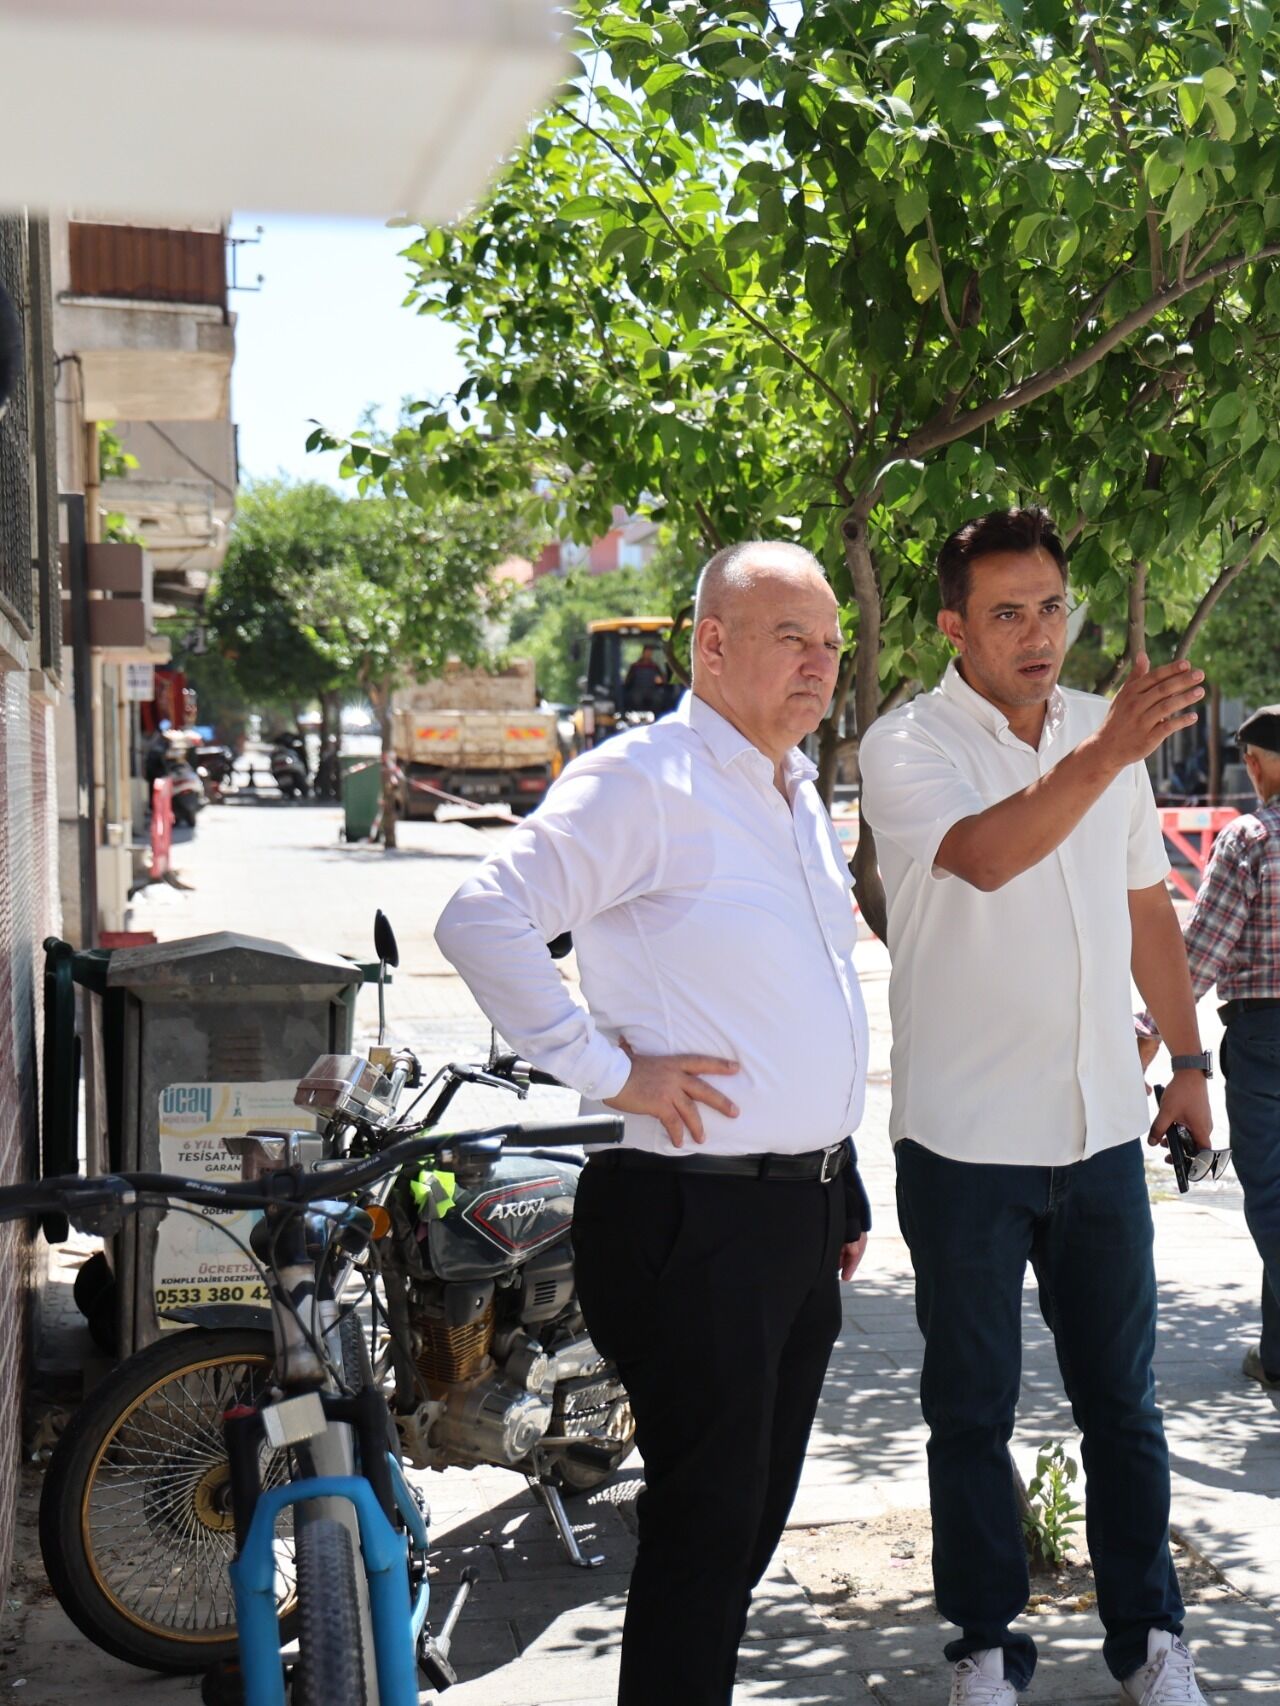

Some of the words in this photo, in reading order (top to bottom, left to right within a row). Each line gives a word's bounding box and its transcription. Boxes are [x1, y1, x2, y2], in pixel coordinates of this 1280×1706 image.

[194, 1140, 215, 1150] YIL
[178, 1149, 227, 1162] TESİSAT
[161, 1276, 195, 1285] KOMPLE
[197, 1275, 222, 1284] DAİRE
[155, 1287, 201, 1304] 0533
[207, 1286, 244, 1301] 380
